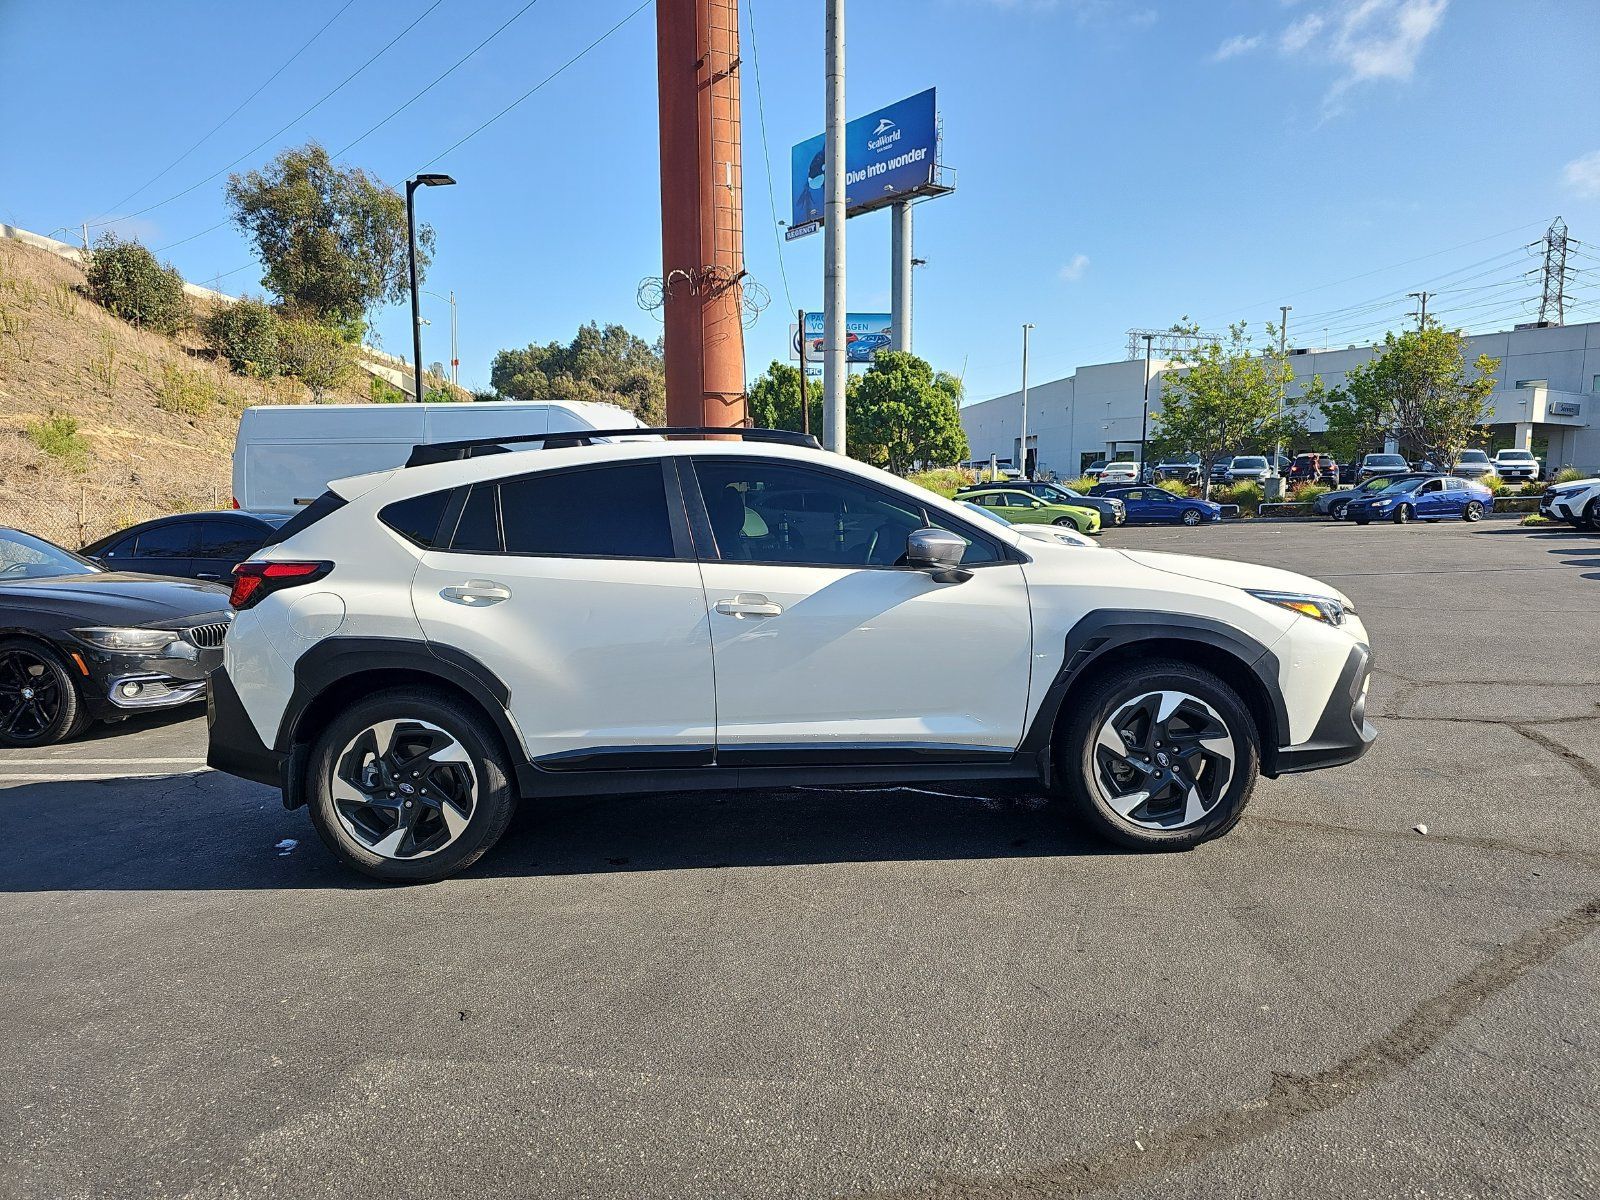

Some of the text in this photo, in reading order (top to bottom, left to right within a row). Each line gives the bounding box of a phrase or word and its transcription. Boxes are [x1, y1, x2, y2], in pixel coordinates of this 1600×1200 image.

[867, 129, 901, 151] SeaWorld
[846, 147, 927, 186] Dive into wonder
[786, 224, 815, 239] REGENCY
